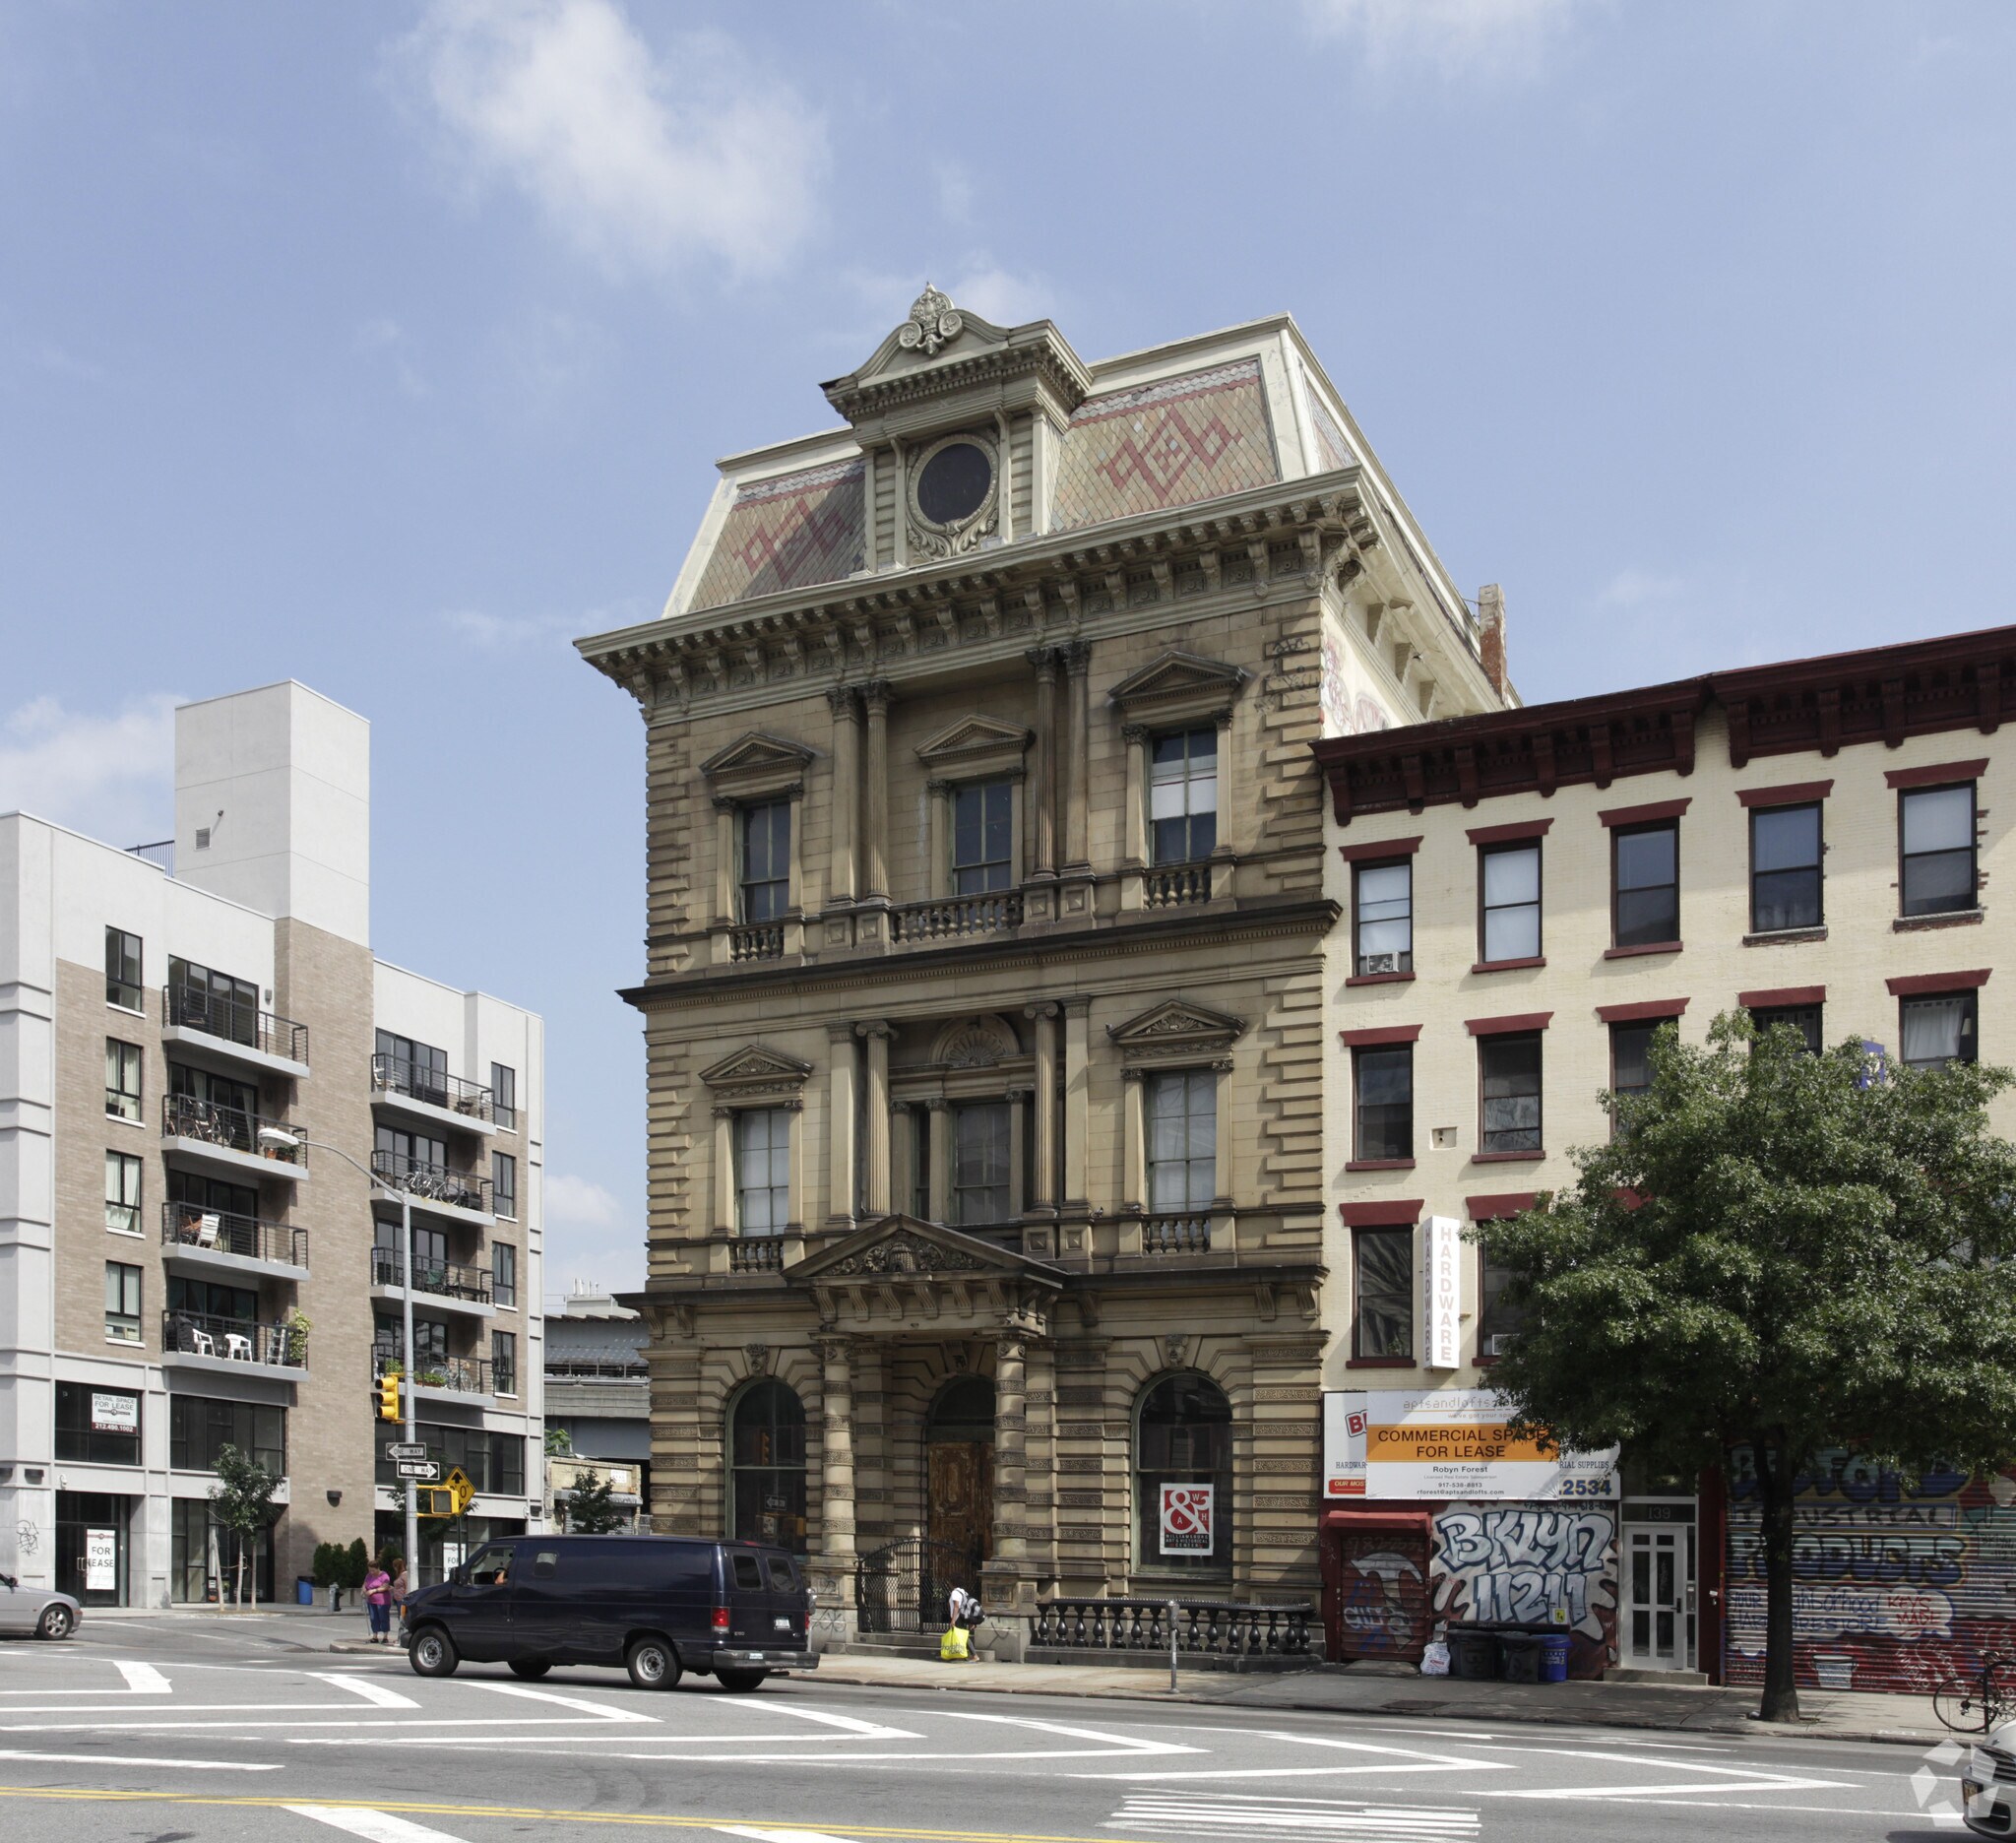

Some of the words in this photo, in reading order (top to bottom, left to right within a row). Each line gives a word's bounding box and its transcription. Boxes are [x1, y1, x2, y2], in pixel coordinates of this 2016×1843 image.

[1438, 1226, 1455, 1363] HARDWARE
[94, 1400, 109, 1409] FOR
[1378, 1430, 1486, 1442] COMMERCIAL
[1417, 1446, 1448, 1458] FOR
[1454, 1445, 1506, 1458] LEASE
[1336, 1461, 1366, 1470] HARDWAR
[1578, 1460, 1609, 1469] SUPPLIES
[1735, 1506, 1948, 1529] IUSTRIAL
[92, 1546, 111, 1556] FOR
[1887, 1595, 1932, 1615] KEYS
[1896, 1611, 1941, 1625] MADE
